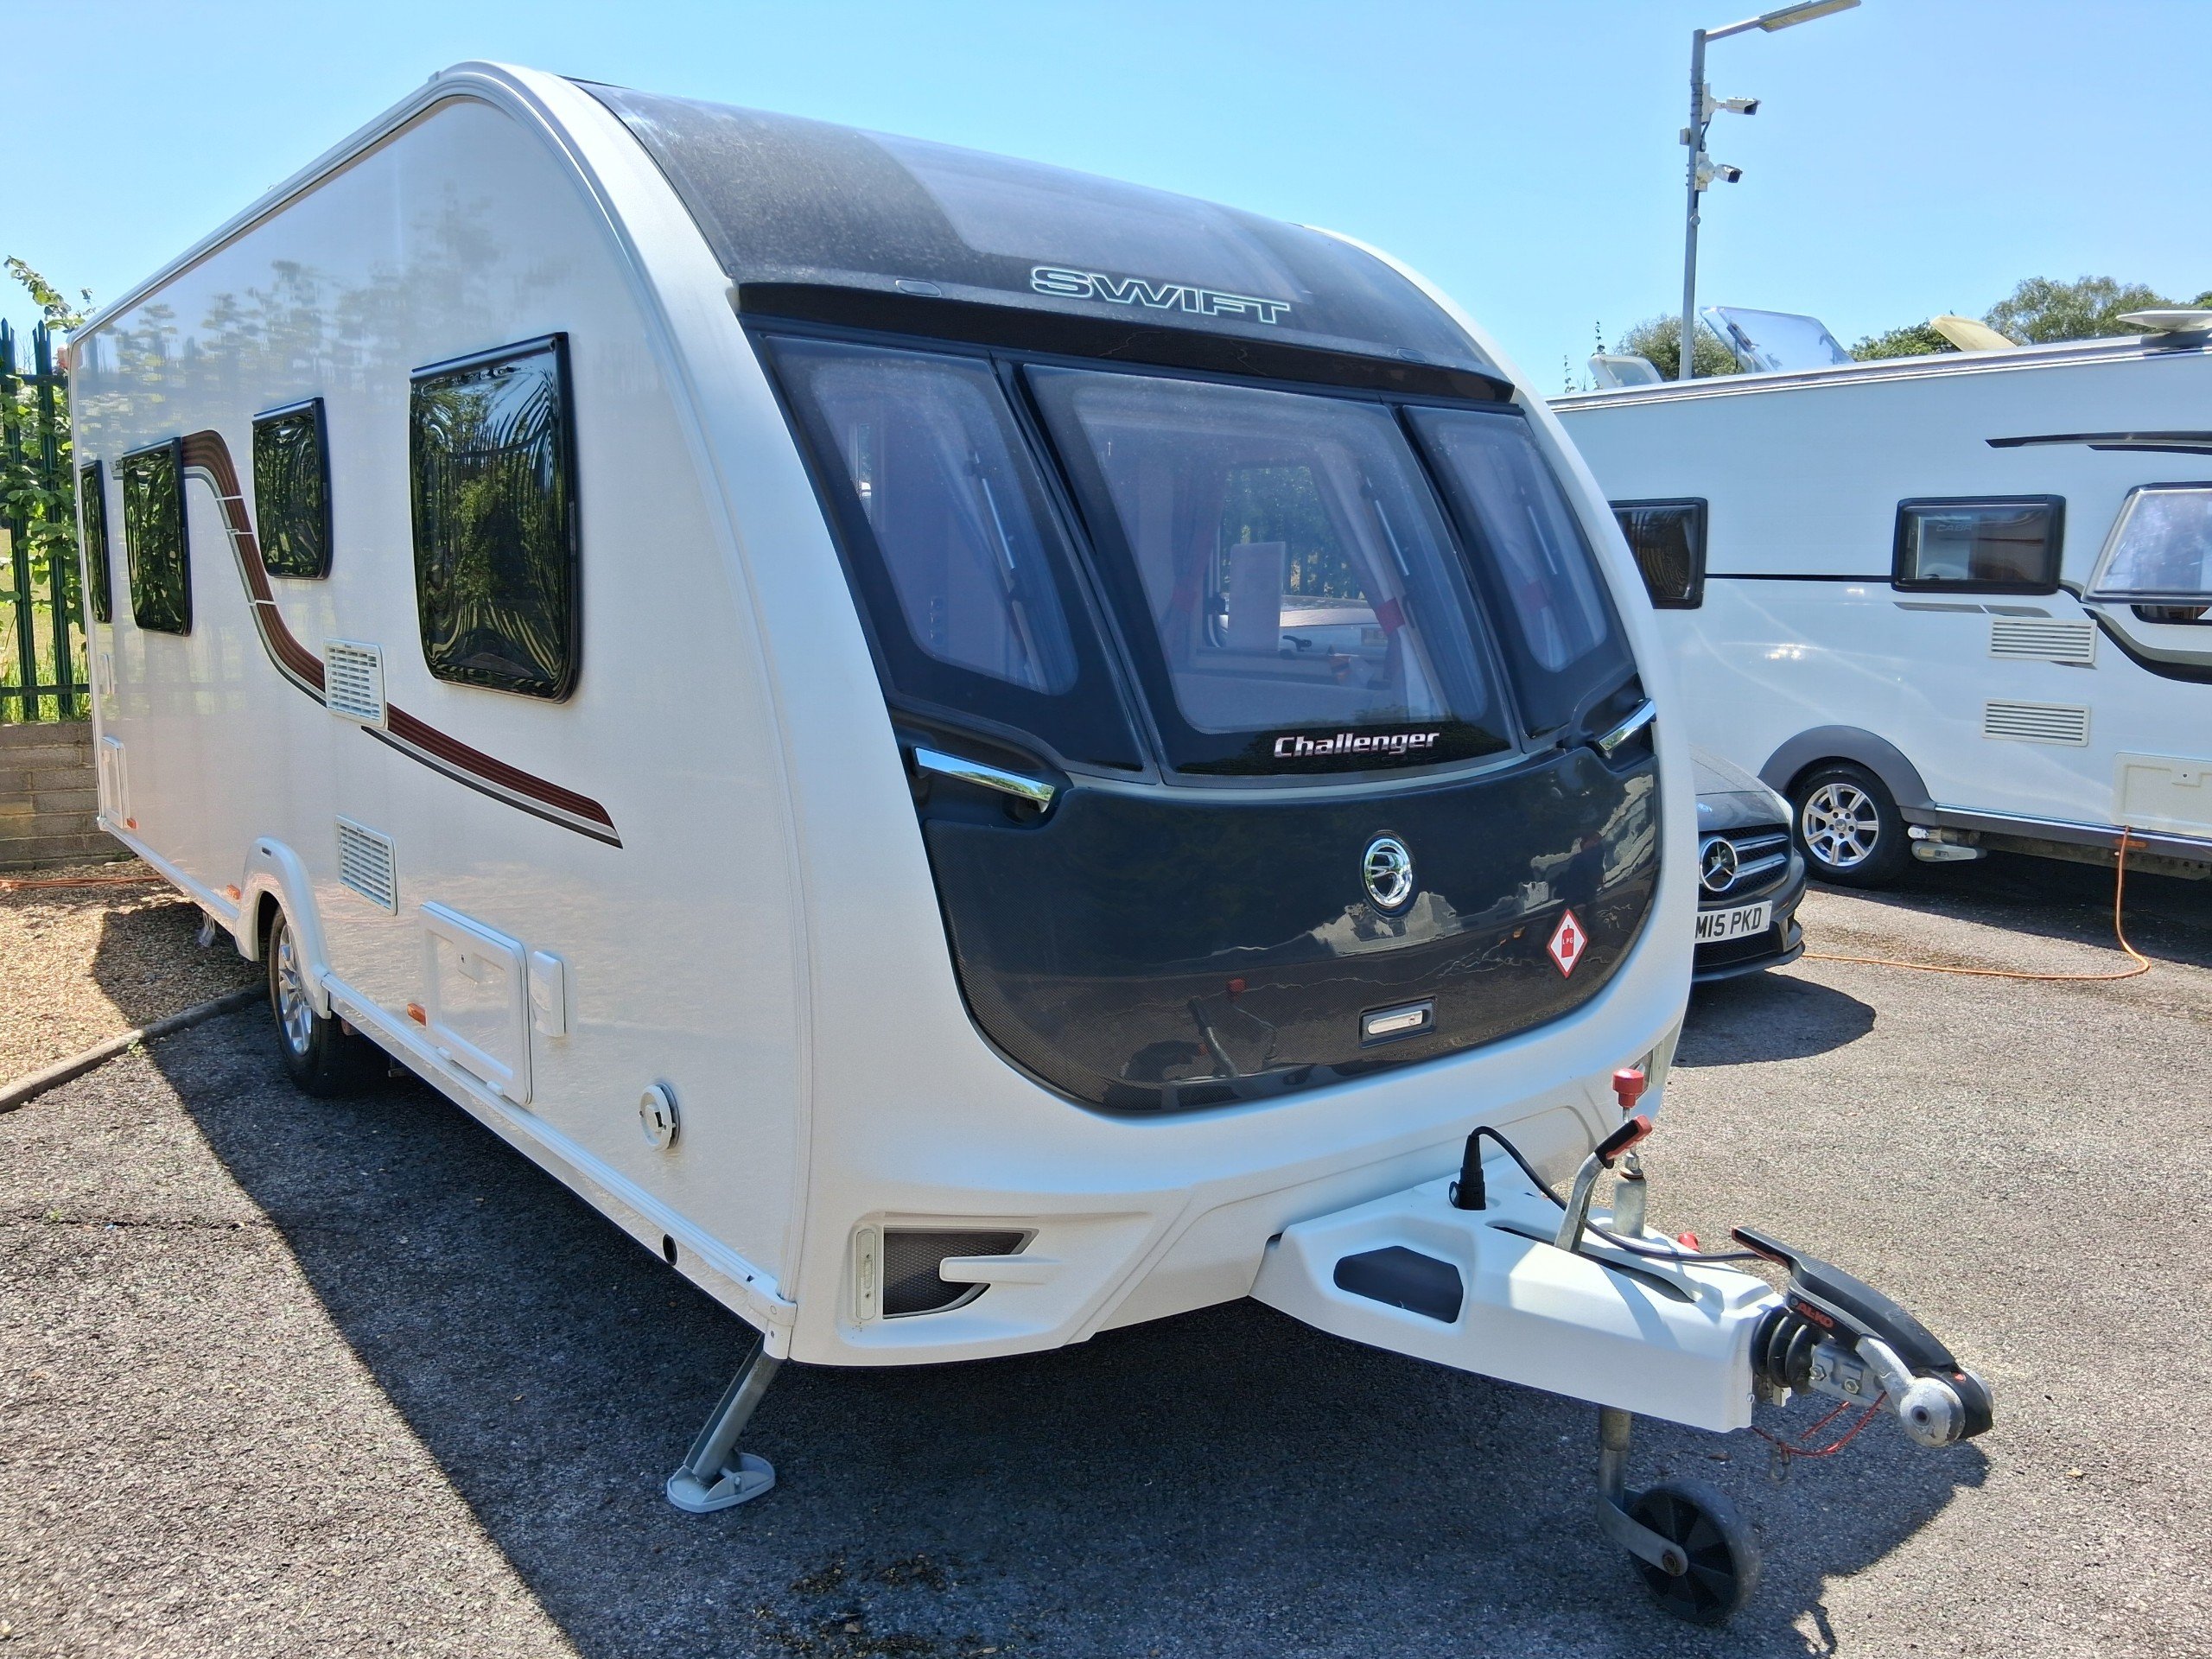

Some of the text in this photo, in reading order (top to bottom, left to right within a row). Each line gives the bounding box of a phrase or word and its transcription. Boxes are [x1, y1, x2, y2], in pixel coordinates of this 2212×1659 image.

[1030, 265, 1291, 324] SWIFT
[1273, 732, 1440, 759] Challenger
[1730, 907, 1762, 934] PKD
